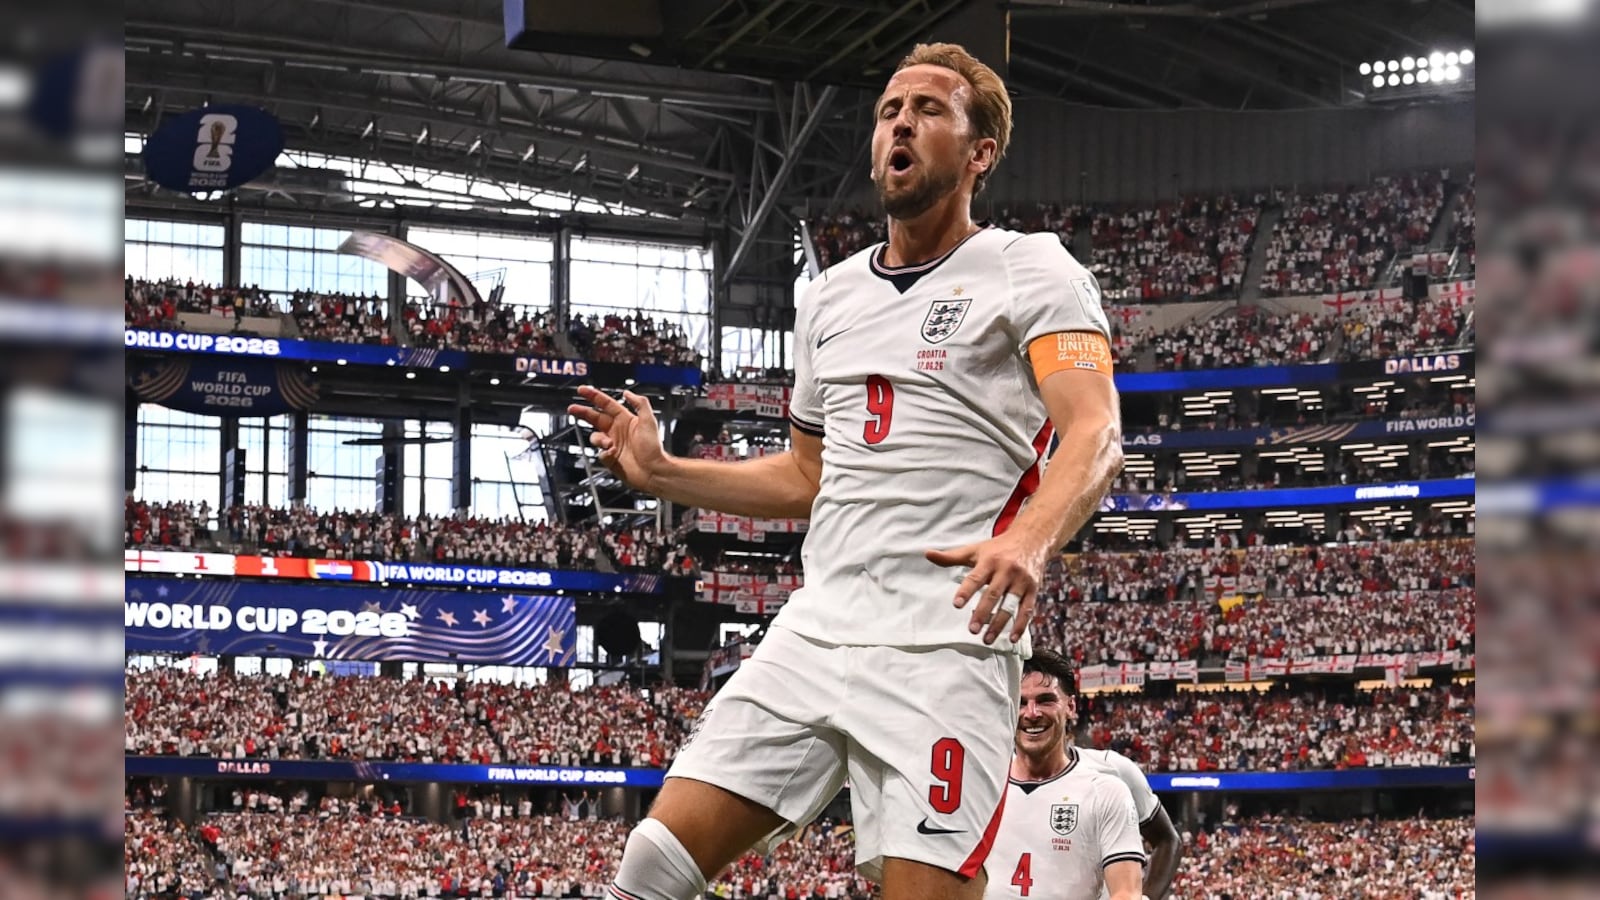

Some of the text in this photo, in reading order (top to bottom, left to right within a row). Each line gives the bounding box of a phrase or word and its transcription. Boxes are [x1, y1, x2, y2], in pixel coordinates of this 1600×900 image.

[175, 333, 213, 351] CUP
[215, 336, 280, 355] 2026
[917, 349, 947, 359] CROATIA
[515, 357, 588, 376] DALLAS
[917, 361, 944, 370] 17.06.26
[1076, 361, 1096, 369] FIFA
[1385, 355, 1460, 374] DALLAS
[217, 371, 247, 383] FIFA
[191, 381, 271, 396] WORLD CUP
[204, 395, 253, 407] 2026
[863, 374, 895, 445] 9
[1386, 421, 1415, 432] FIFA
[1416, 417, 1464, 430] WORLD
[194, 555, 279, 575] 1 1
[409, 567, 464, 582] WORLD
[466, 570, 497, 584] CUP
[498, 571, 552, 586] 2026
[125, 602, 408, 637] WORLD CUP 2026
[217, 762, 271, 774] DALLAS
[488, 768, 515, 780] FIFA
[516, 769, 558, 781] WORLD
[559, 770, 583, 781] CUP
[928, 736, 965, 815] 9
[1011, 852, 1033, 897] 4
